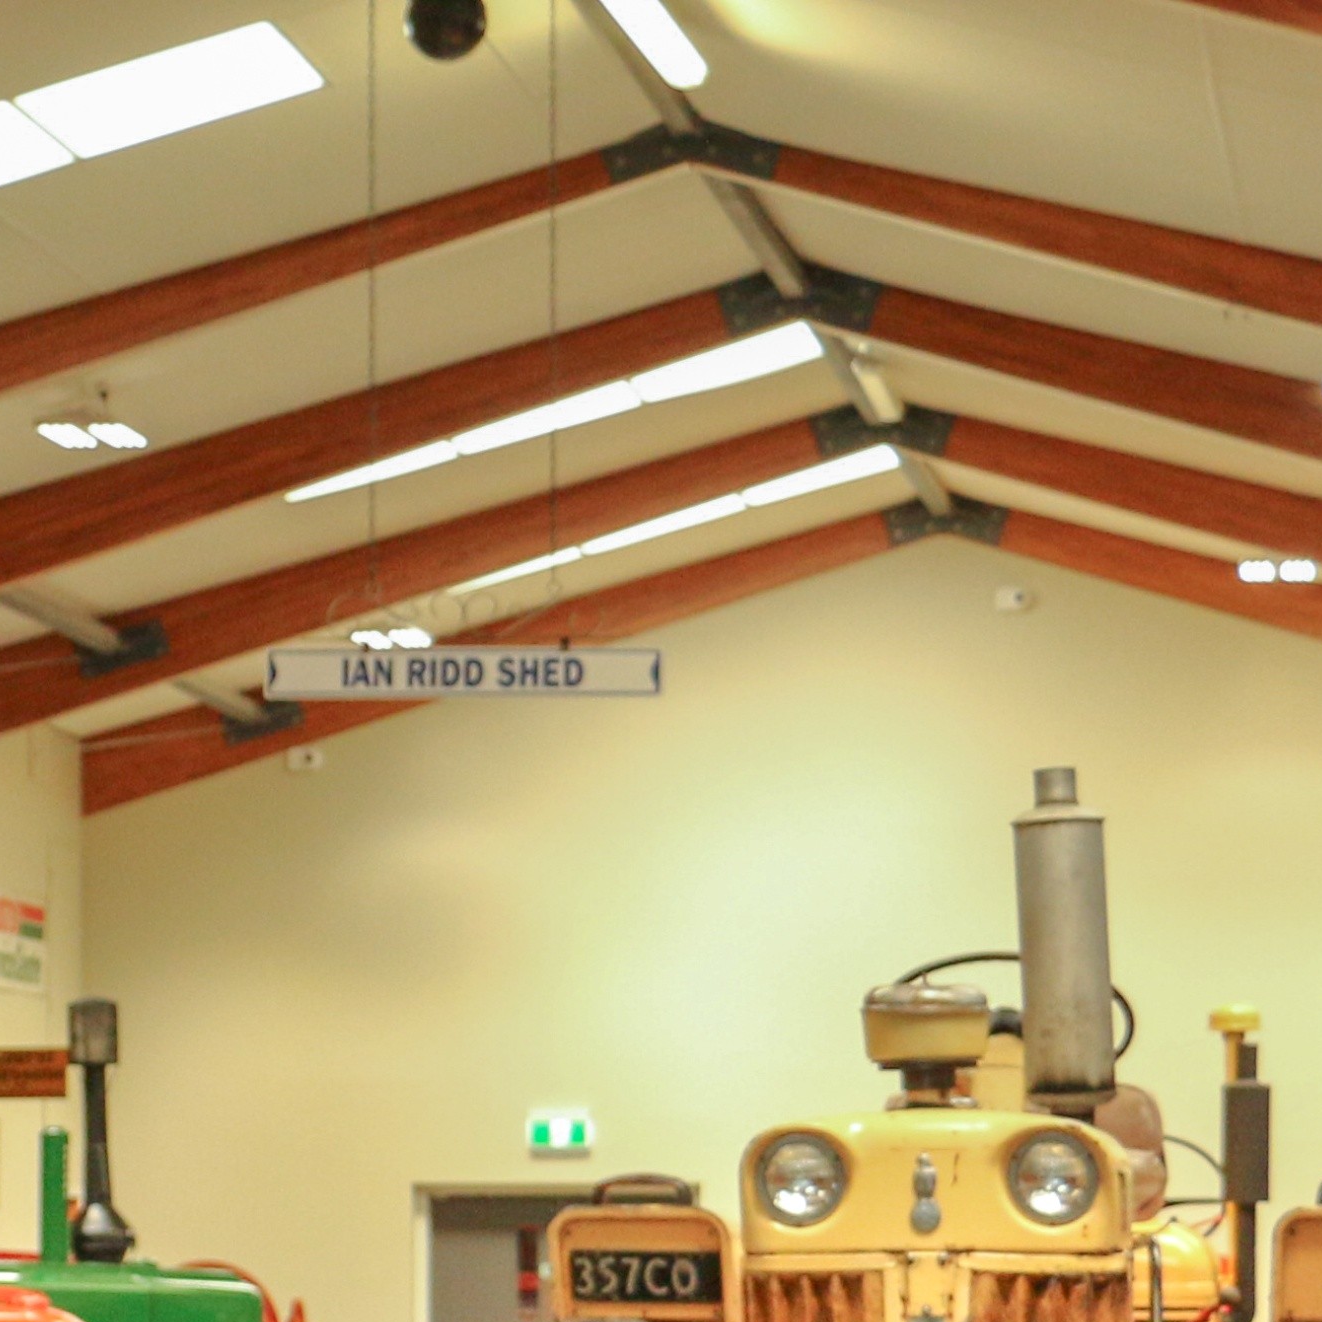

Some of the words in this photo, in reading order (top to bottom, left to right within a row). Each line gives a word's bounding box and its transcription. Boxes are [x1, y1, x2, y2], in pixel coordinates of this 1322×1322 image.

[341, 658, 393, 687] IAN
[407, 658, 484, 687] RIDD
[498, 657, 585, 688] SHED
